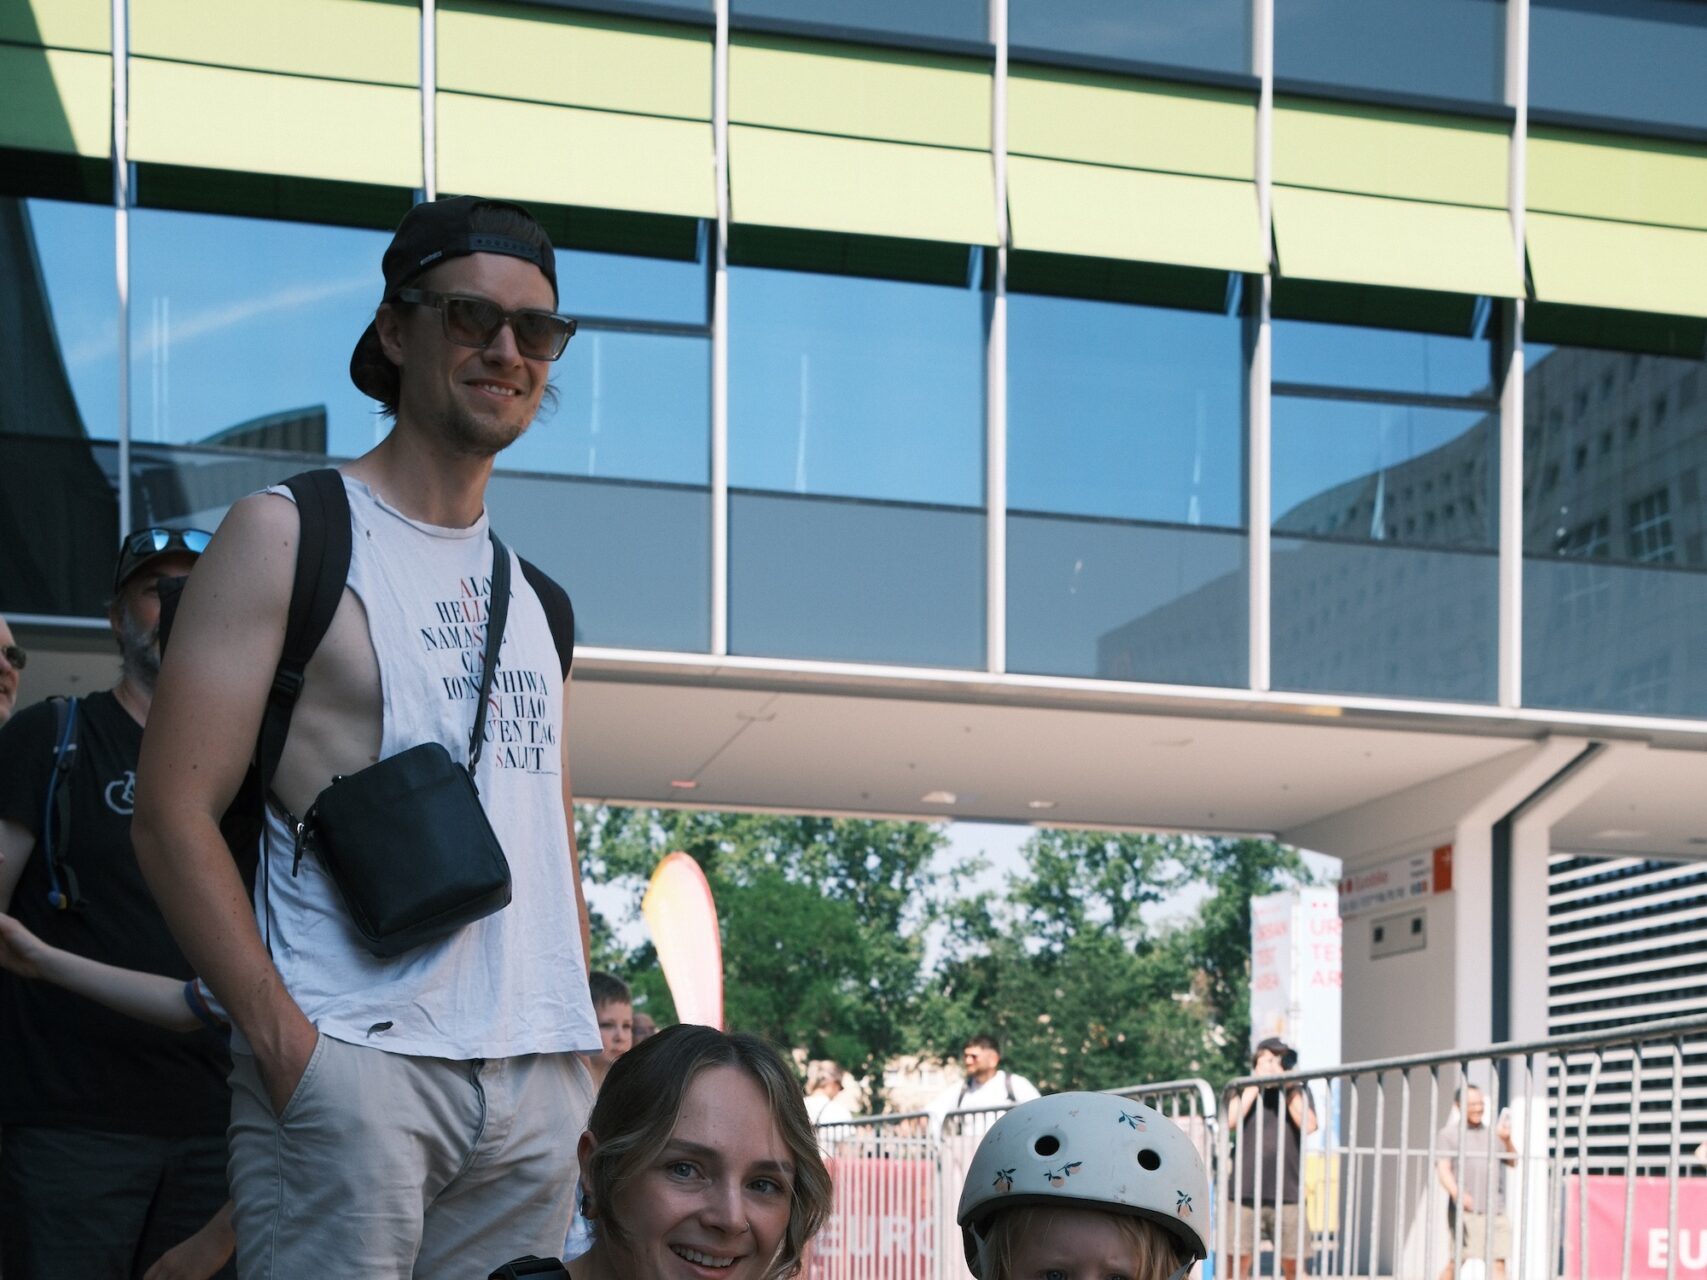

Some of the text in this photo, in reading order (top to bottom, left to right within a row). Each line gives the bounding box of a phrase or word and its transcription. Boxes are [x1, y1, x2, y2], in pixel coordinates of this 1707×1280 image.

[420, 623, 507, 651] NAMAS
[461, 649, 501, 673] CIA
[513, 695, 546, 719] HAO
[527, 720, 556, 745] TAG
[495, 746, 545, 770] SALUT
